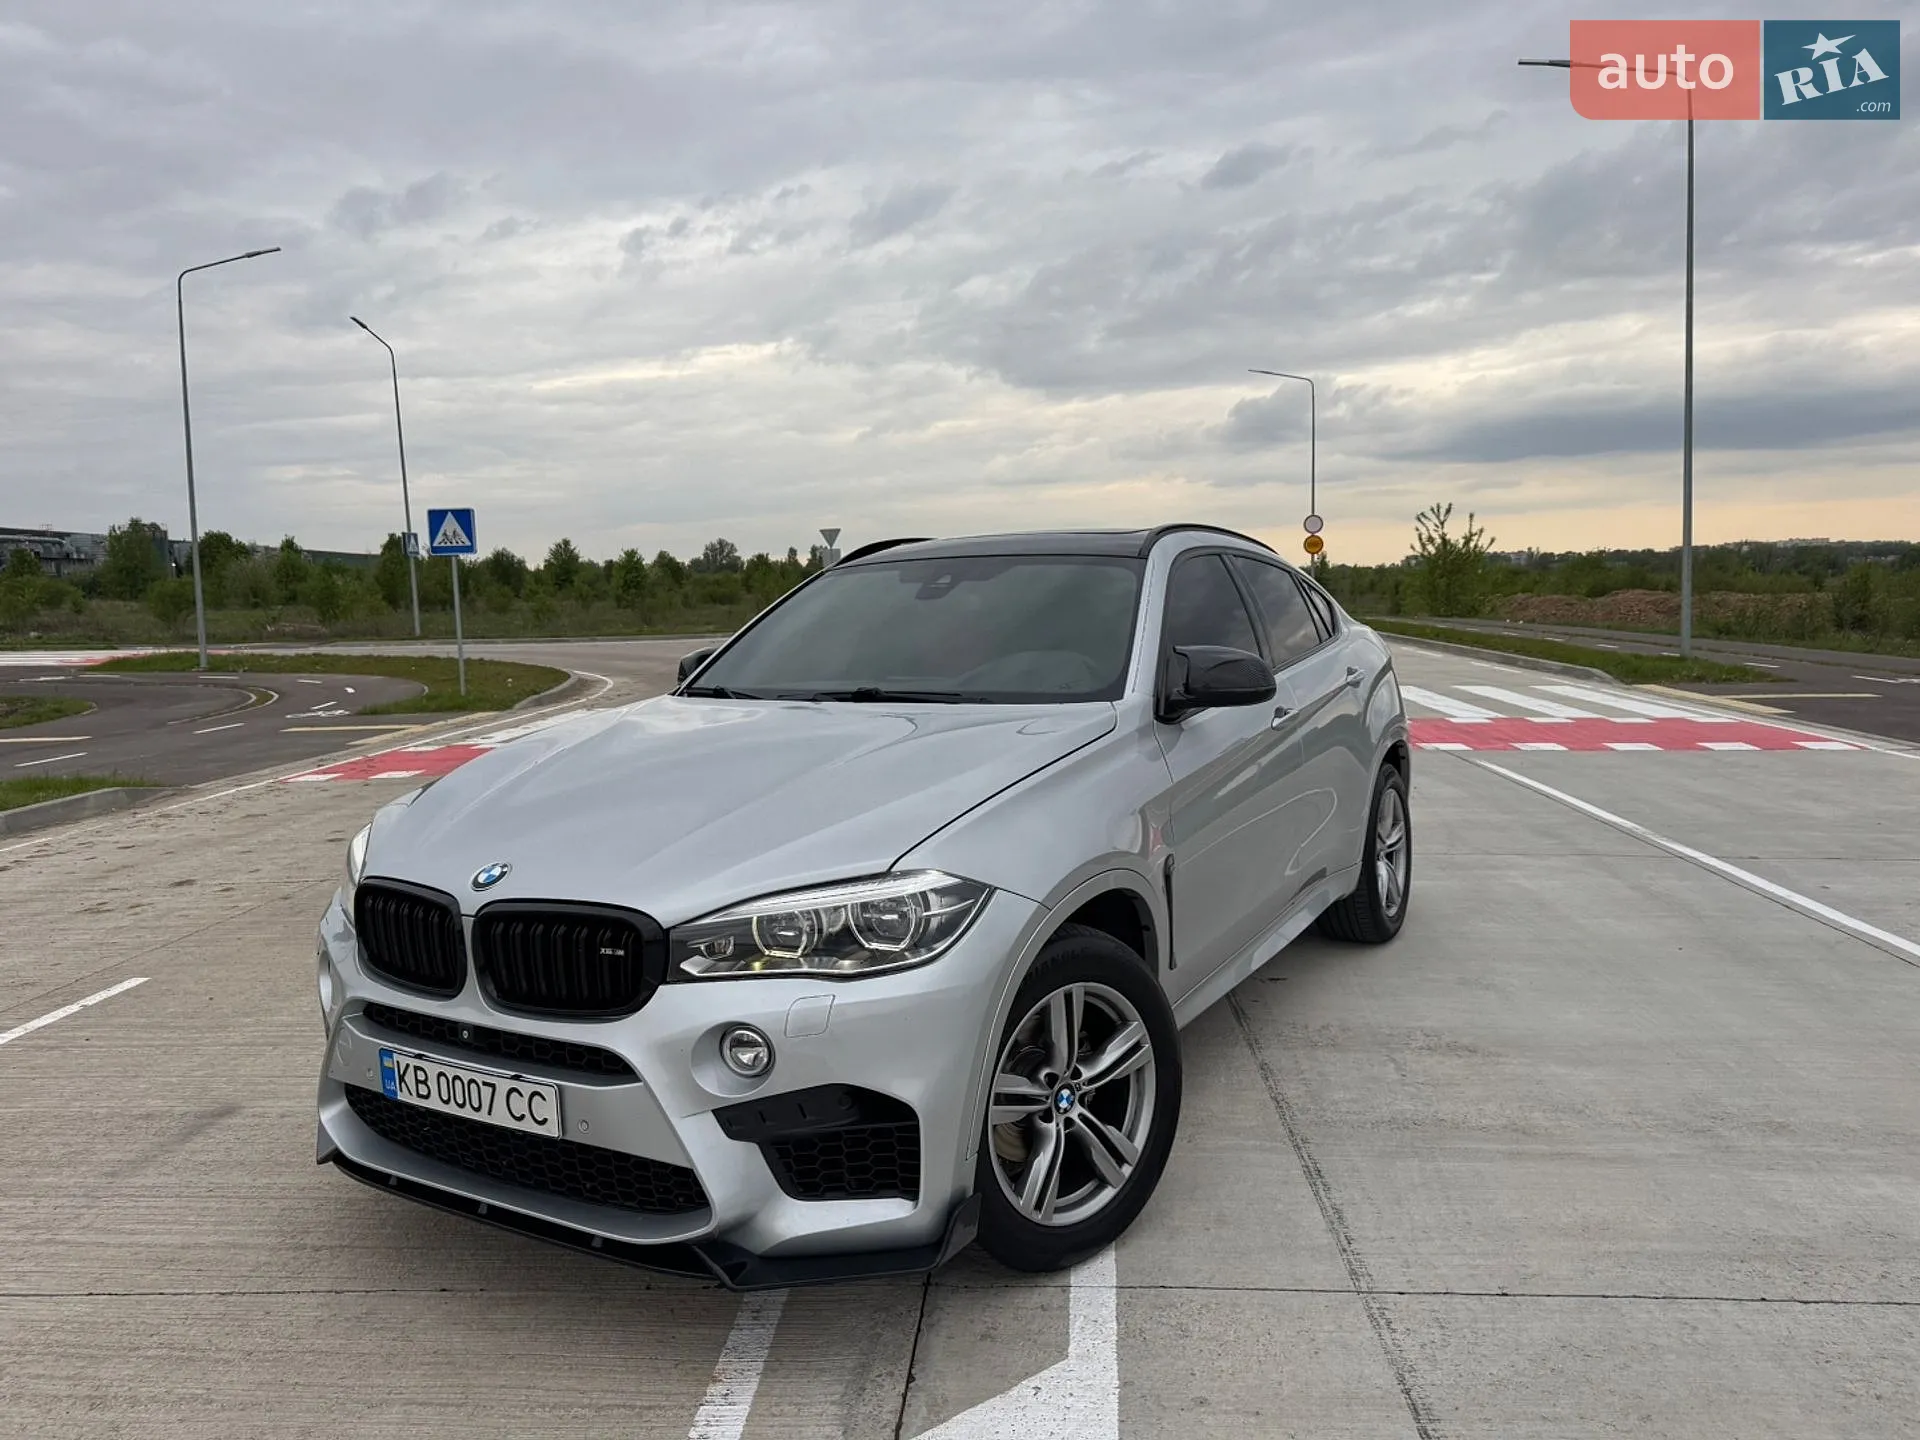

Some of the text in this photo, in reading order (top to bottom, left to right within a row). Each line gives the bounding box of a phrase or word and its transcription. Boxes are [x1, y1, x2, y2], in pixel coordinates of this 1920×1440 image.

[396, 1060, 548, 1126] KB 0007 CC
